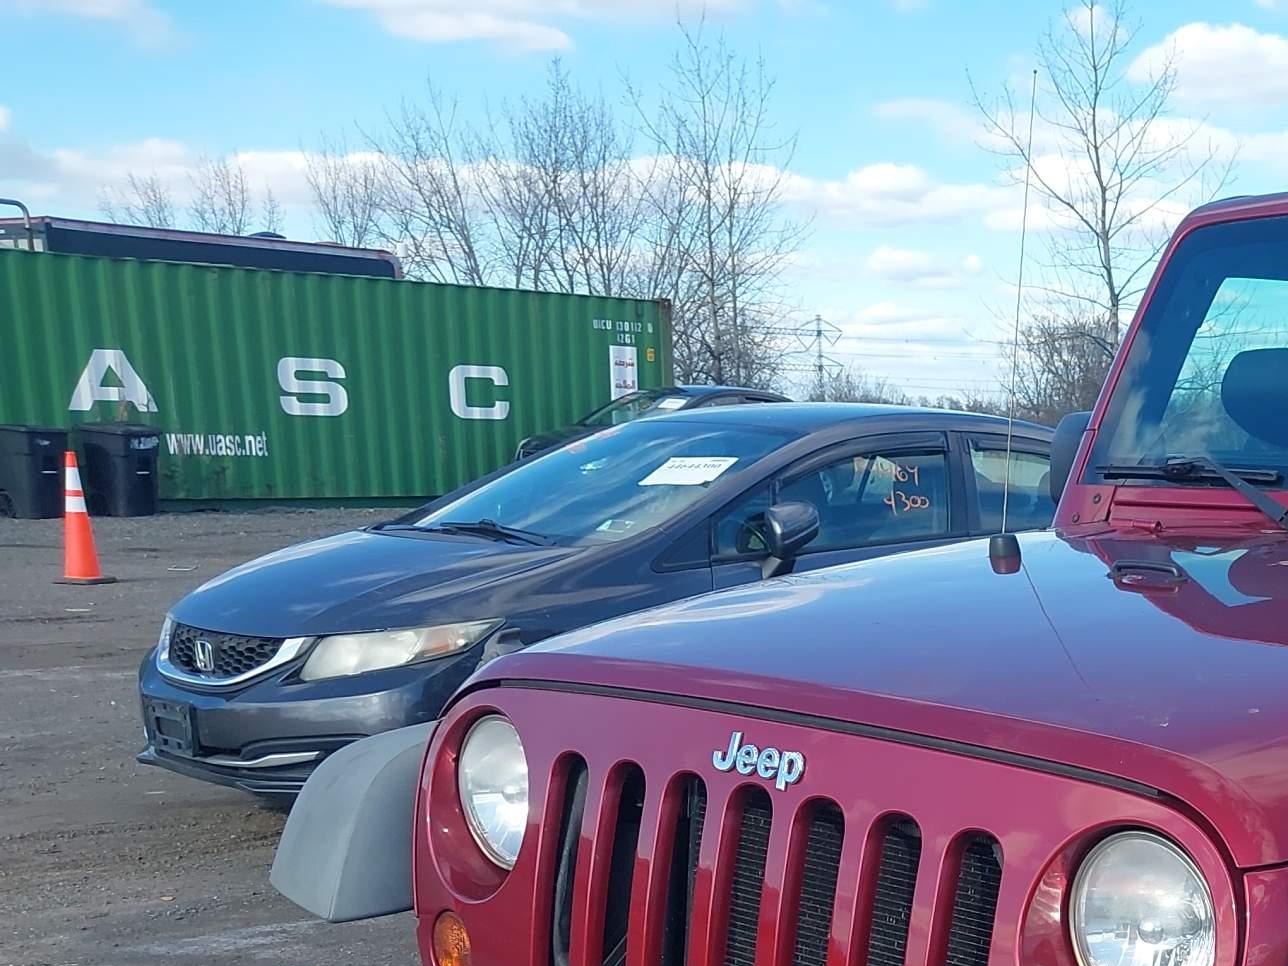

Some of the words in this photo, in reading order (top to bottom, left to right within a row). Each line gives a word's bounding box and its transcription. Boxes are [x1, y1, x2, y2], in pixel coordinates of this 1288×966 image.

[68, 349, 158, 412] A
[277, 357, 349, 417] S
[448, 364, 510, 420] C
[165, 431, 269, 457] www.uasc.net
[883, 490, 930, 517] 4300
[712, 731, 805, 791] Jeep
